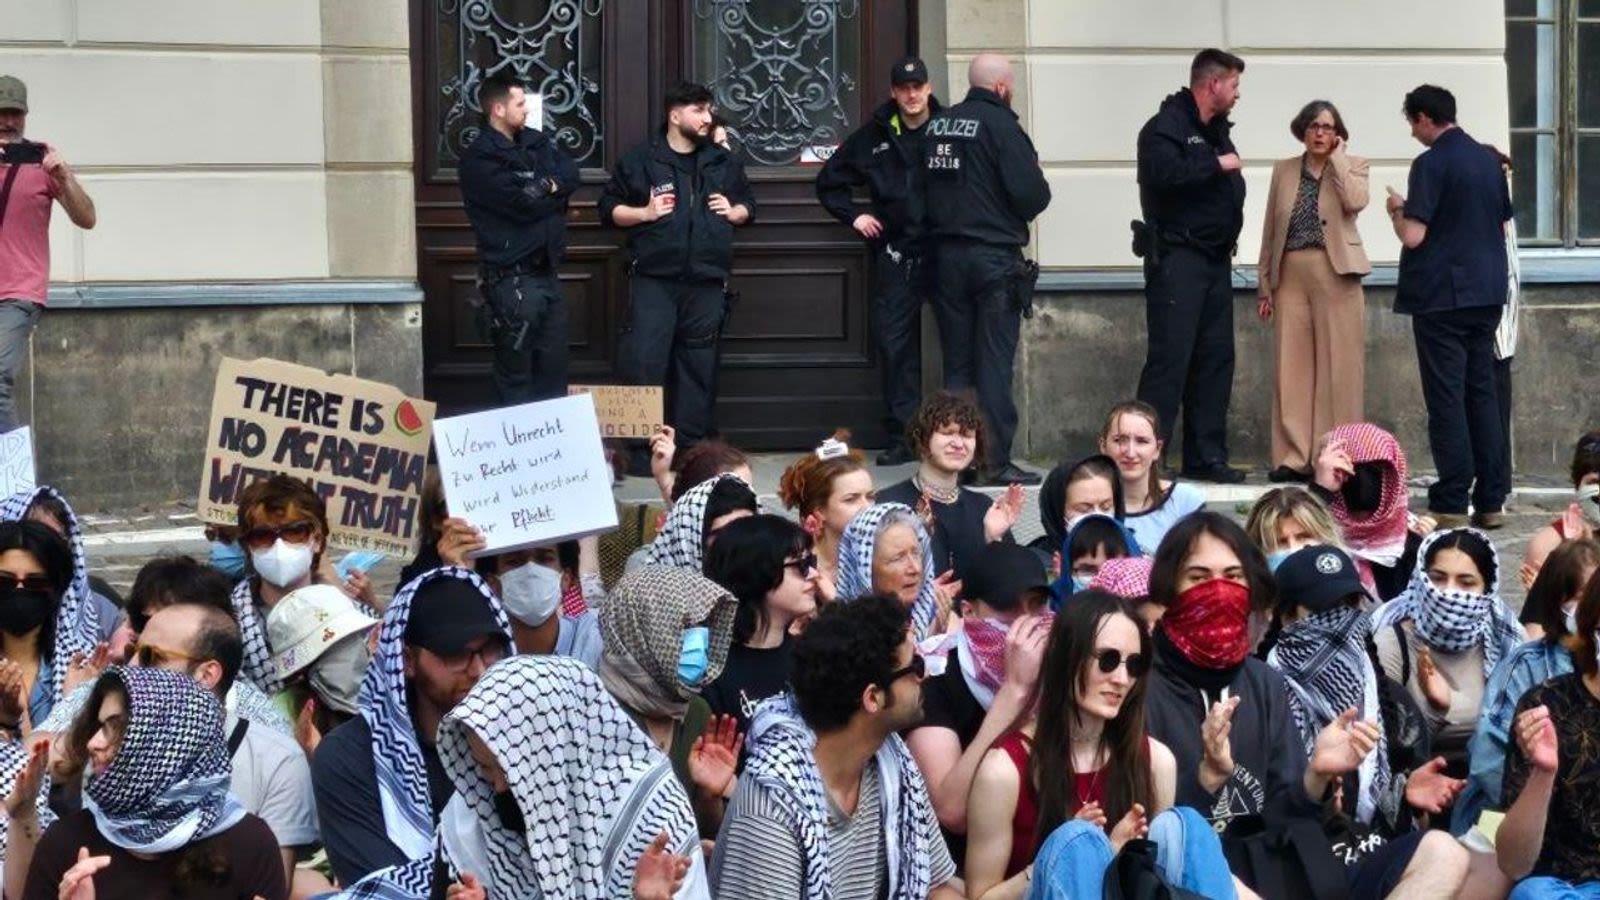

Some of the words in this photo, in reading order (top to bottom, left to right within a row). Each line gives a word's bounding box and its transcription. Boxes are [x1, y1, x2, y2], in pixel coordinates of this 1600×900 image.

[925, 118, 980, 138] POLIZEI
[936, 144, 952, 155] BE
[235, 376, 343, 428] THERE
[350, 399, 385, 435] IS
[502, 418, 564, 447] Unrecht
[218, 417, 267, 458] NO
[272, 426, 425, 494] ACADEMIA
[340, 486, 418, 538] TRUTH
